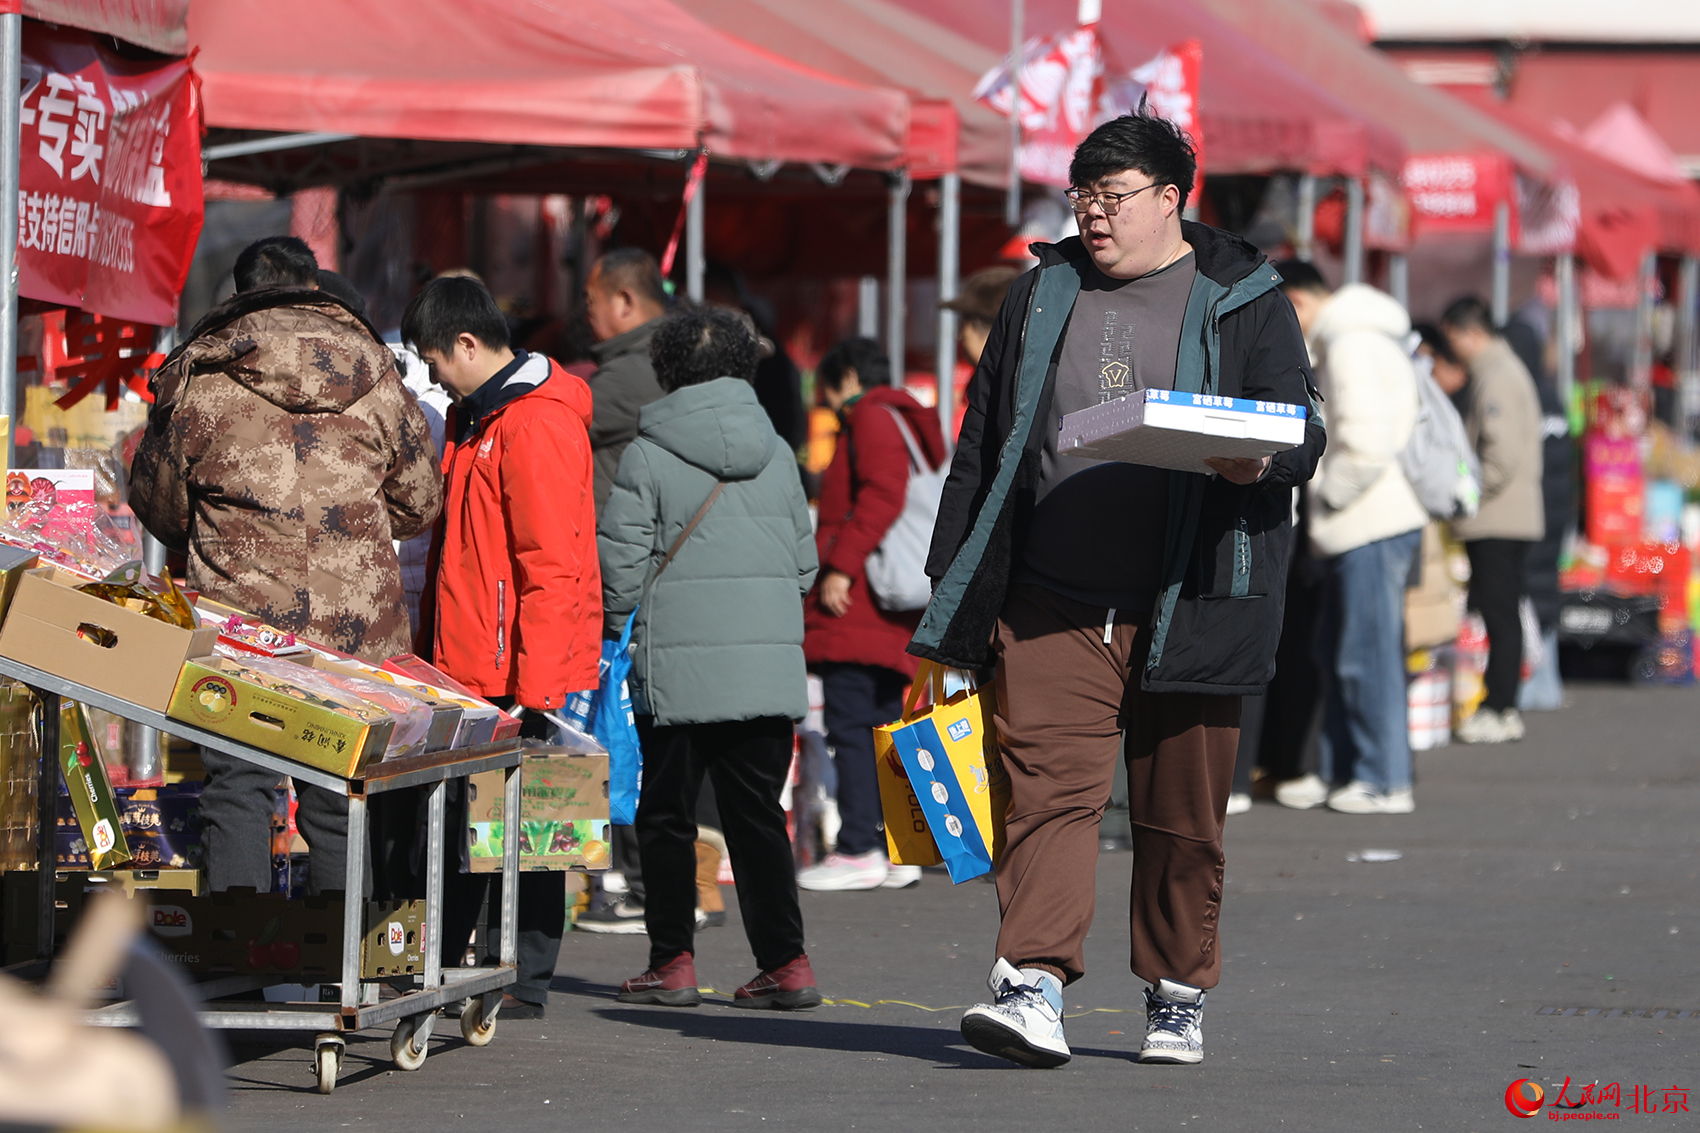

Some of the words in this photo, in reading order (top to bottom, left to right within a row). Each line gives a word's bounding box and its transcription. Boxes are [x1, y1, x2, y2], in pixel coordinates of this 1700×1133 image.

[1192, 393, 1234, 409] 富硒草莓
[1255, 400, 1297, 416] 富硒草莓
[85, 773, 98, 803] Cherries
[96, 825, 109, 848] Dole
[154, 910, 187, 925] Dole
[391, 927, 403, 942] Dole
